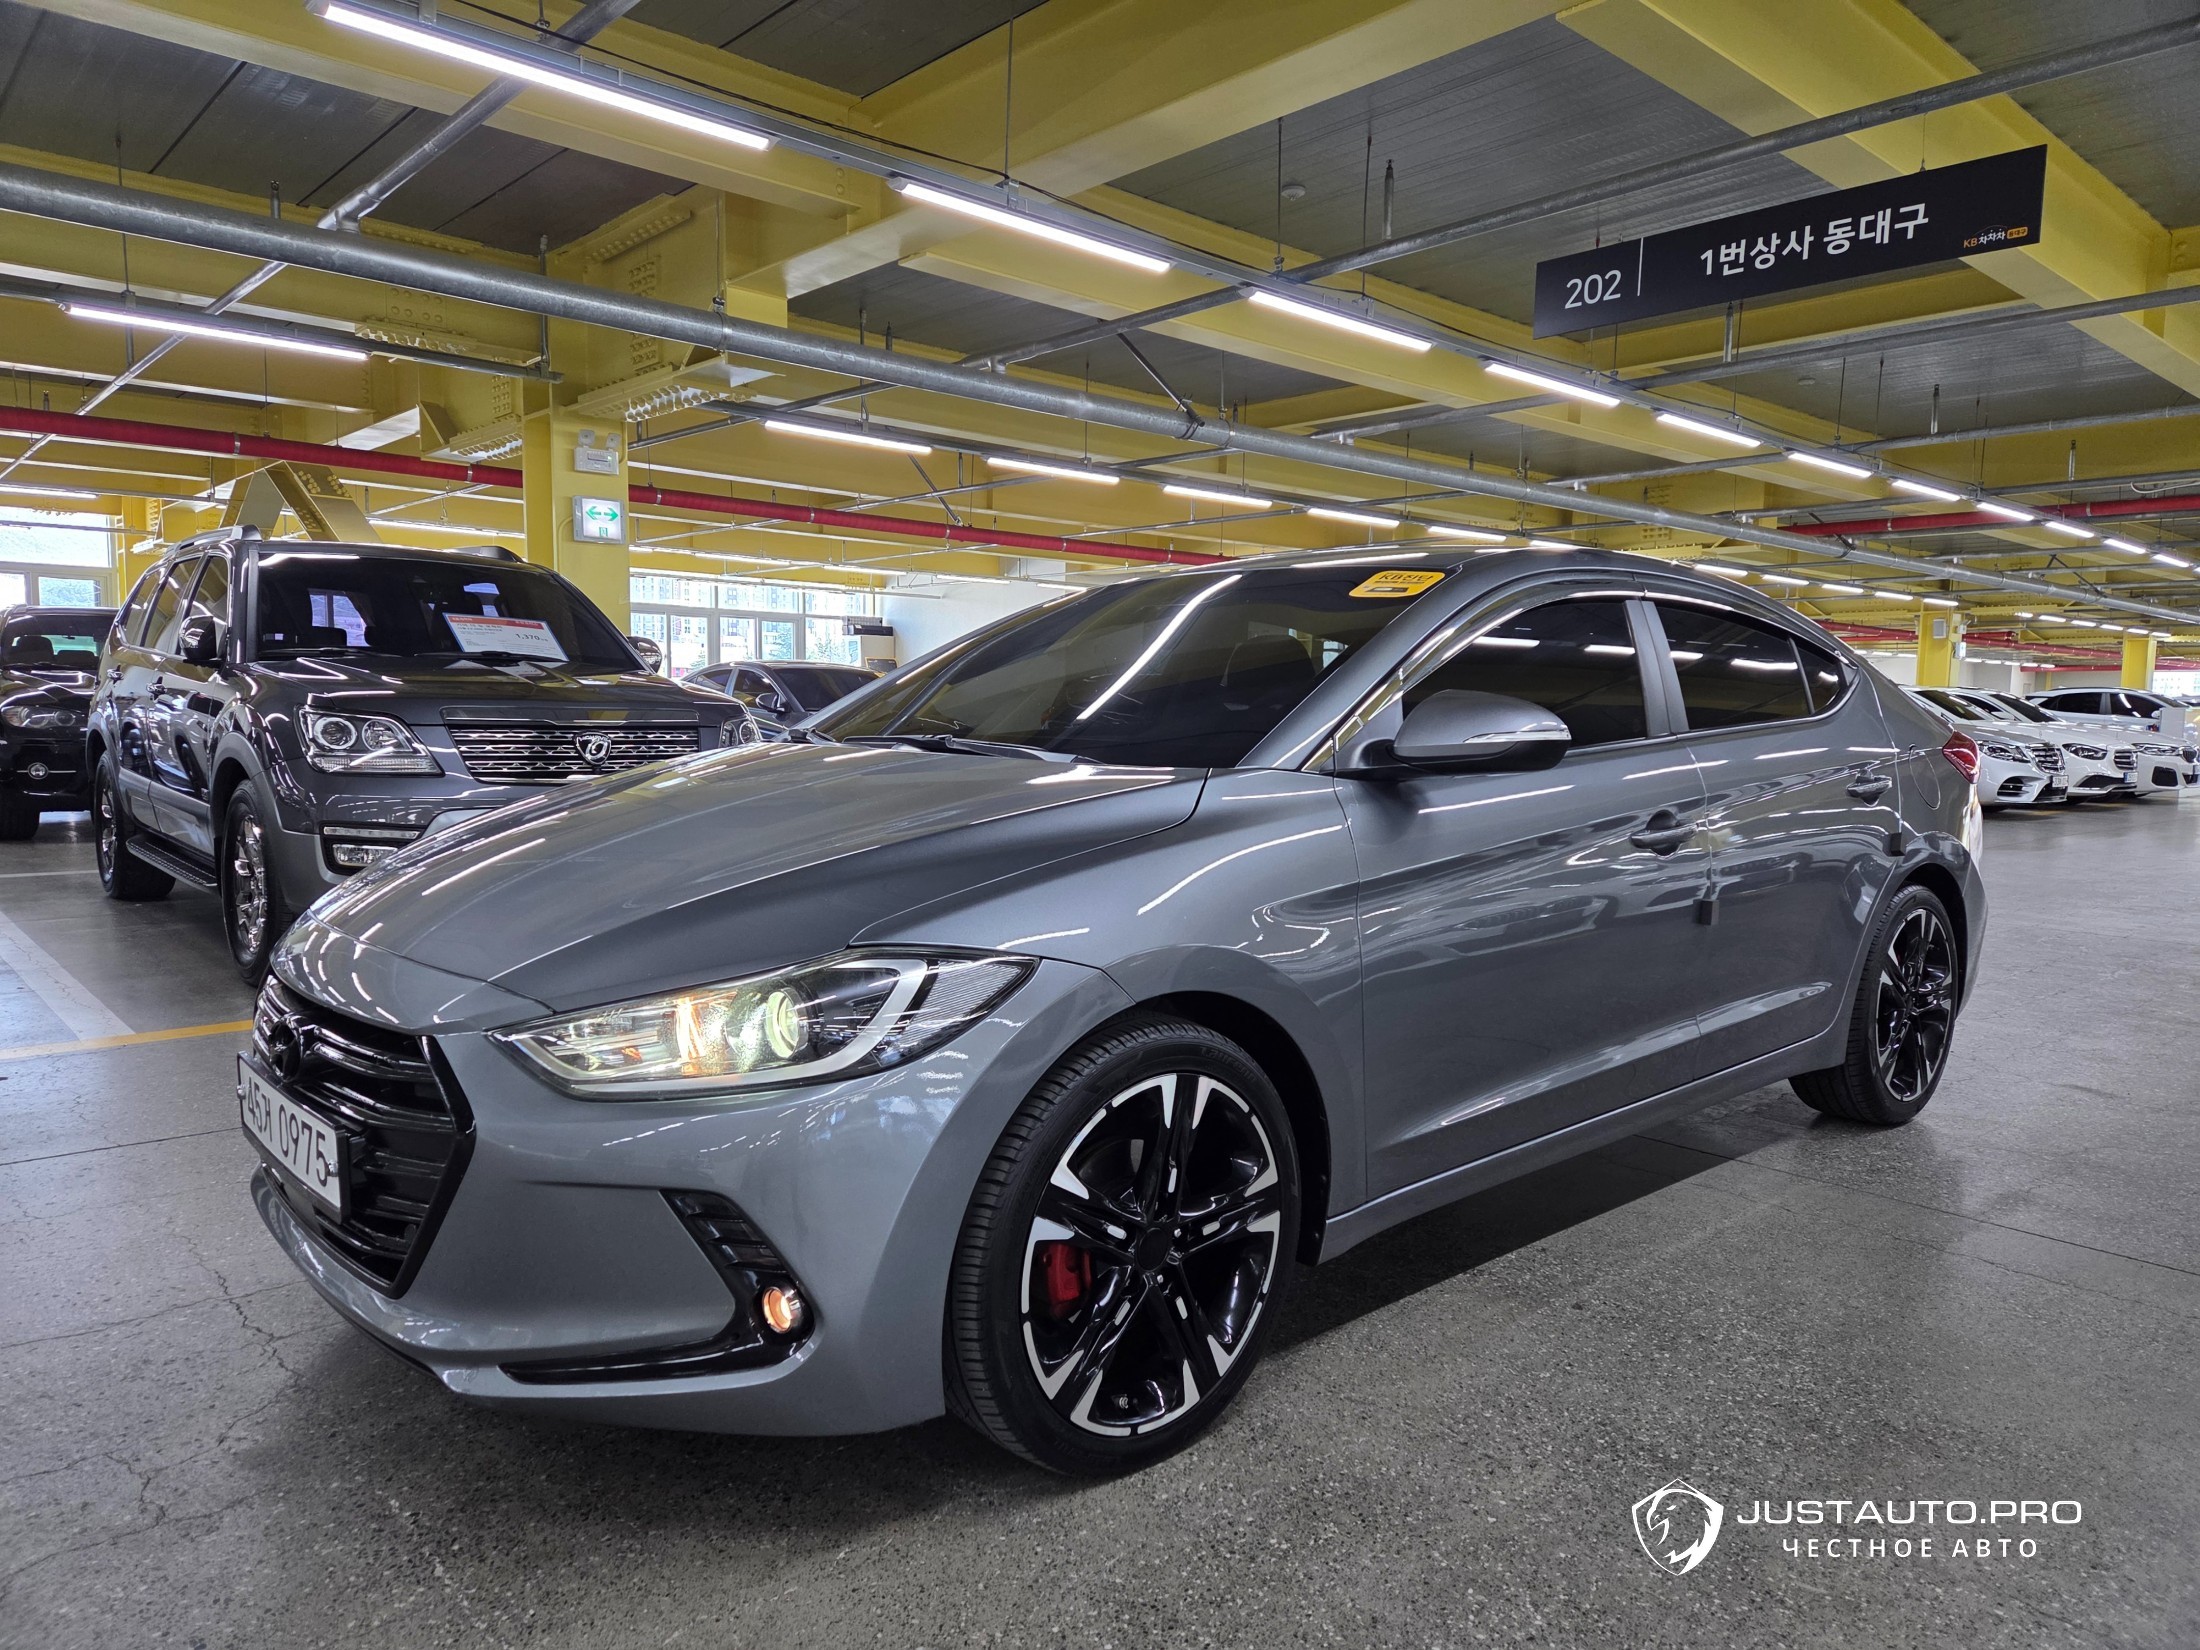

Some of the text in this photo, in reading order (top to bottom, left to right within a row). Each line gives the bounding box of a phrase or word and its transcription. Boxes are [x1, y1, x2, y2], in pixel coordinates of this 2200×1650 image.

[1700, 203, 1929, 276] 1번상사 동대구
[1564, 269, 1622, 309] 202
[278, 1103, 329, 1188] 0975
